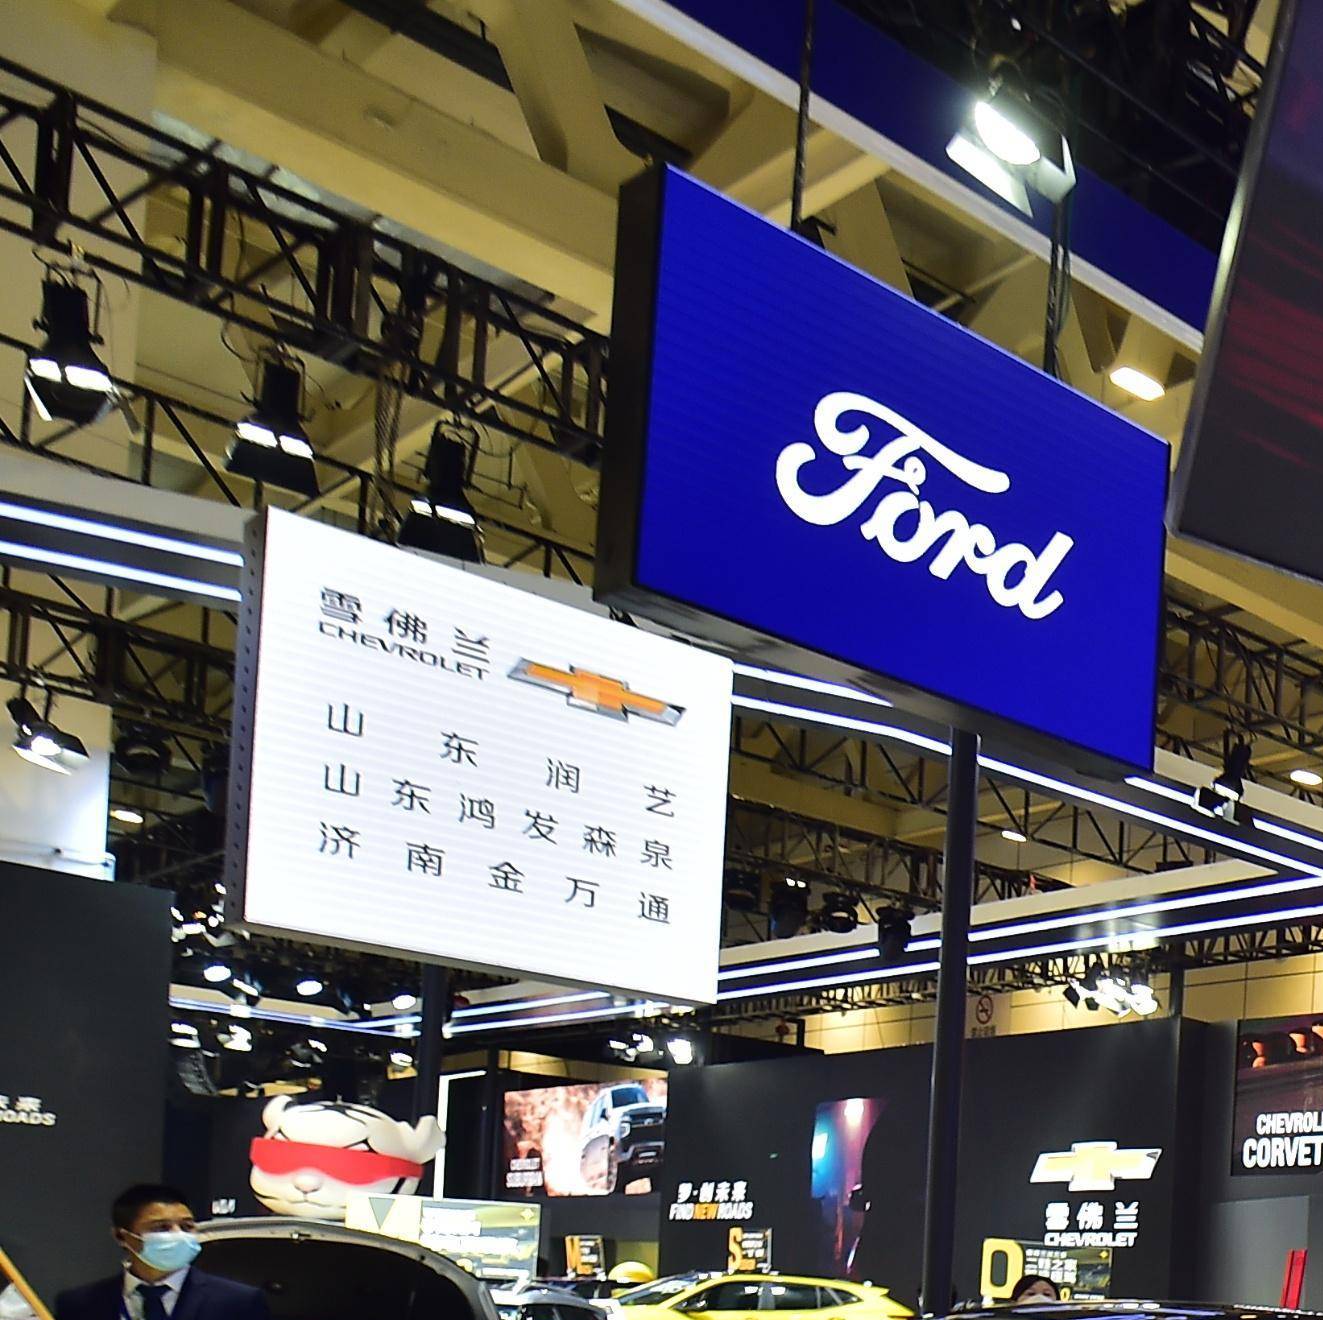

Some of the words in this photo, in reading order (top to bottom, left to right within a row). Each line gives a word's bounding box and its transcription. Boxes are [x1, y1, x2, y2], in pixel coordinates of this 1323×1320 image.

[775, 391, 1075, 620] Ford
[319, 586, 490, 664] 雪佛兰
[319, 621, 491, 680] CHEVROLET
[327, 702, 678, 819] 山东润艺
[323, 763, 675, 870] 山东鸿发森泉
[318, 821, 672, 926] 济南金万通
[1044, 1232, 1138, 1247] CHEVROLET
